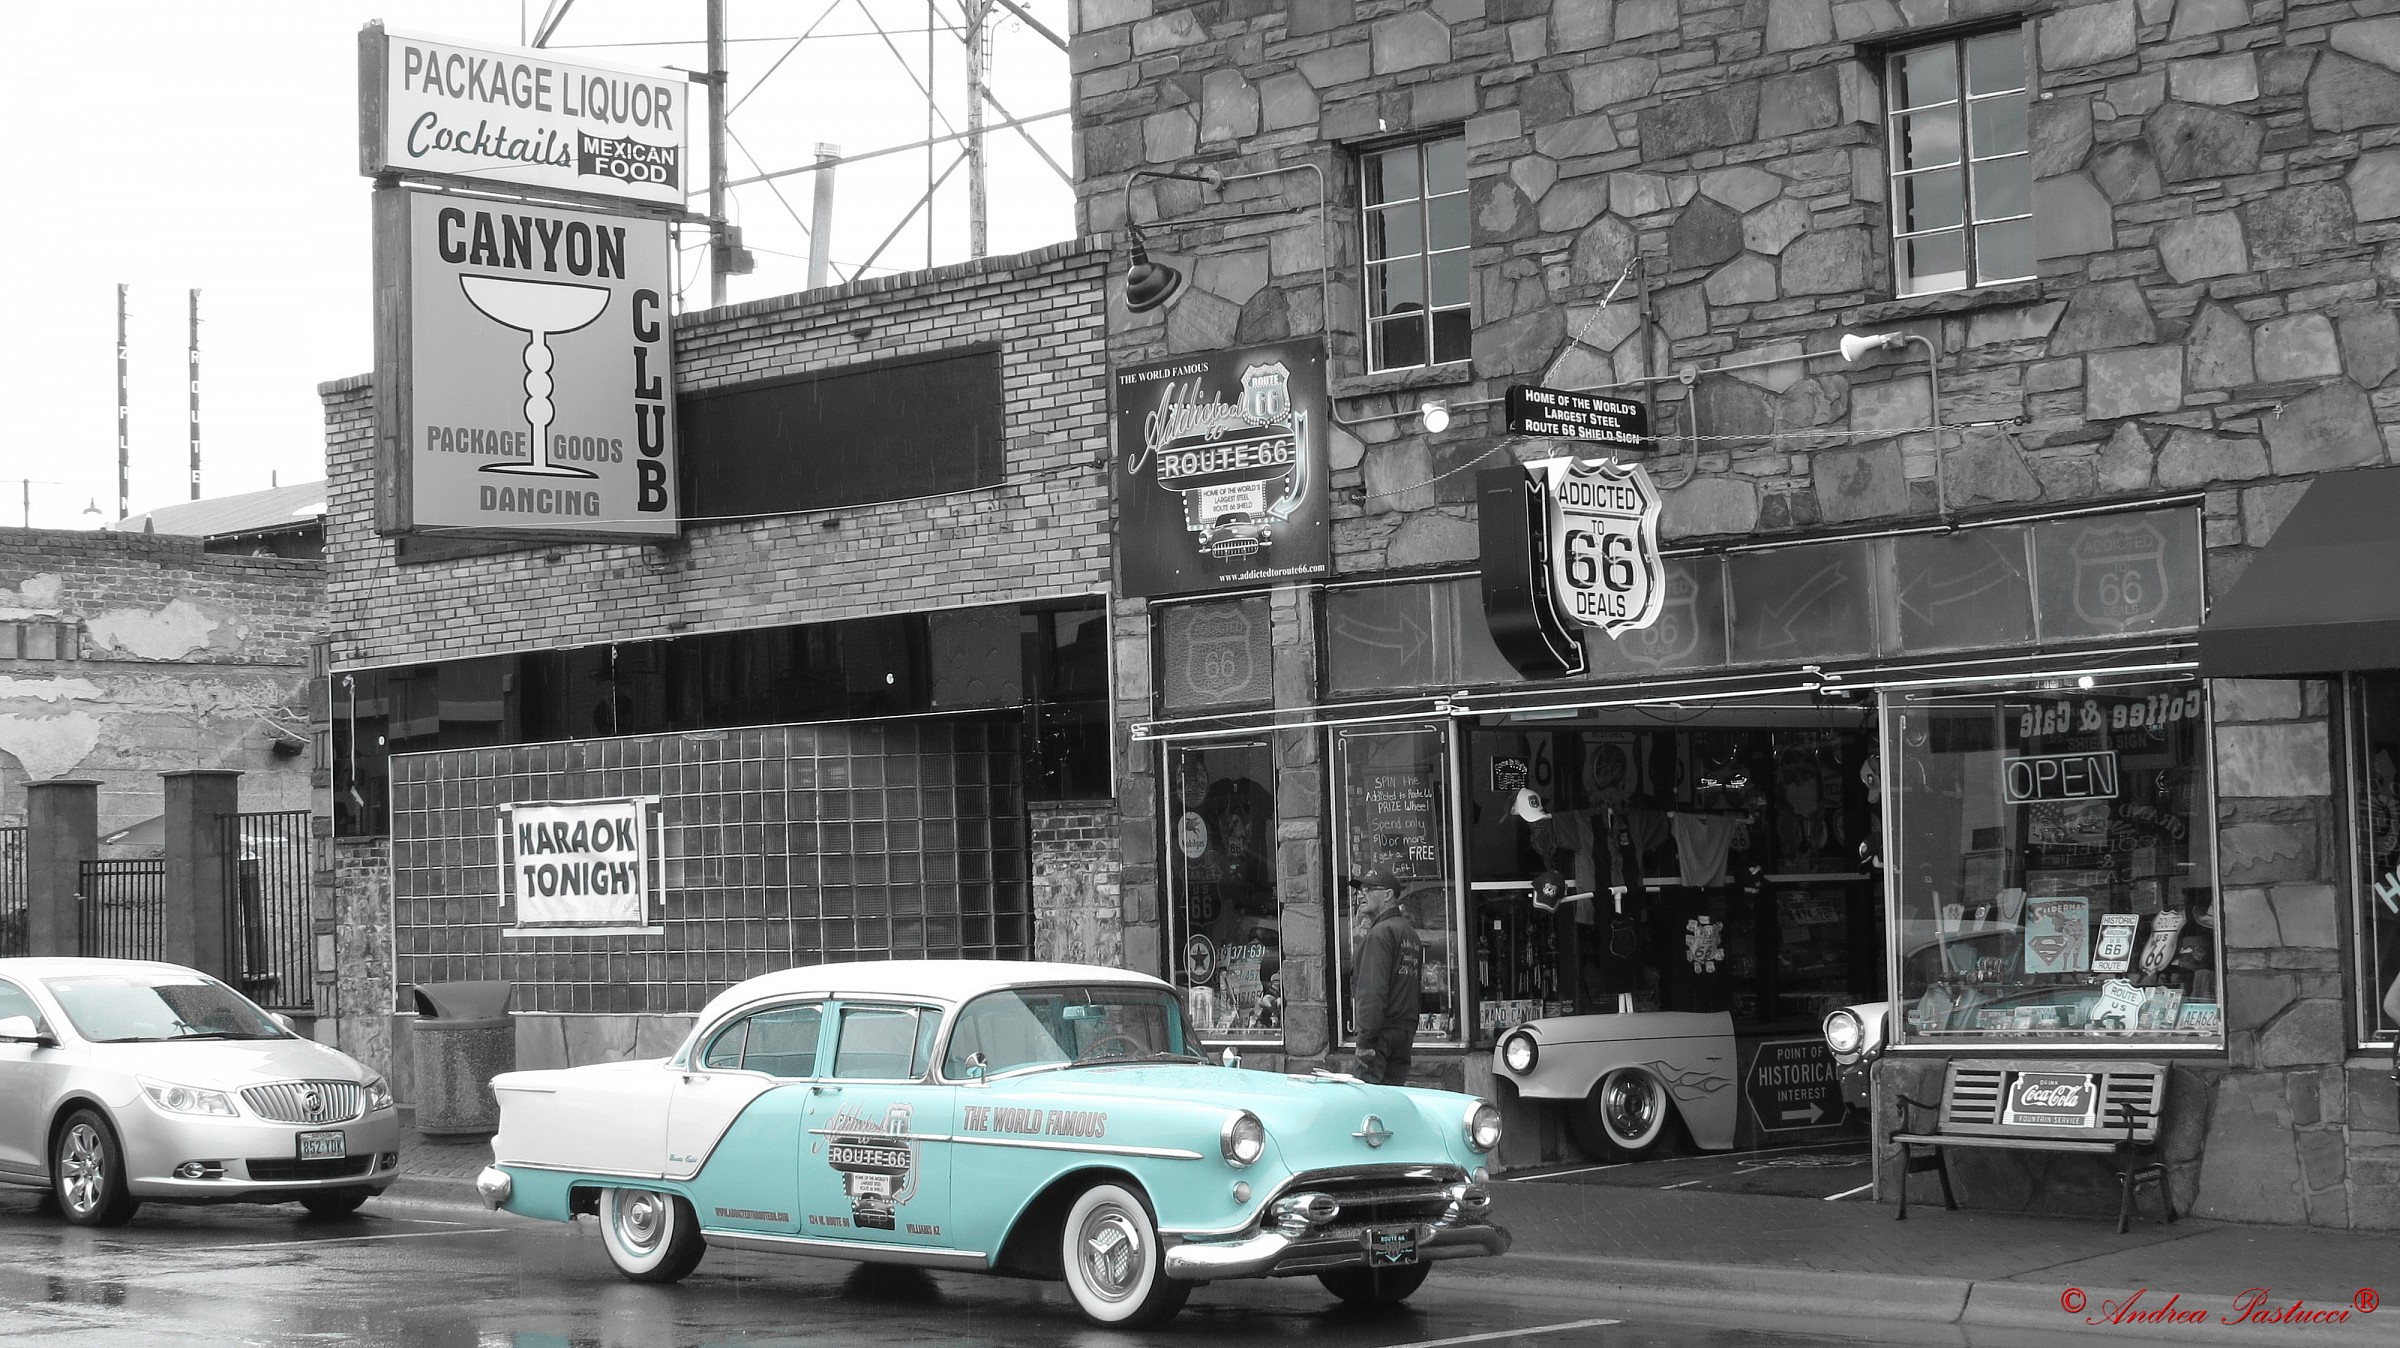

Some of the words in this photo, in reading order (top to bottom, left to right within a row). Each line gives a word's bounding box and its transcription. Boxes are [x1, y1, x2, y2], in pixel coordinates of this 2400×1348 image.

[404, 46, 553, 113] PACKAGE
[563, 72, 673, 131] LIQUOR
[407, 111, 571, 168] Cocktails
[583, 137, 675, 166] MEXICAN
[595, 157, 668, 184] FOOD
[438, 207, 626, 279] CANYON
[1119, 373, 1138, 385] THE
[1138, 368, 1171, 382] WORLD
[1172, 362, 1209, 377] FAMOUS
[1251, 373, 1280, 386] ROUTE
[632, 288, 668, 512] CLUB
[1255, 389, 1279, 416] 66
[1525, 389, 1556, 404] HOME
[1558, 395, 1570, 406] OF
[1572, 397, 1591, 409] THE
[1593, 399, 1636, 416] WORLD'S
[1128, 377, 1245, 475] Addicted
[1545, 406, 1587, 423] LARGEST
[1590, 413, 1621, 428] STEEL
[1205, 421, 1230, 441] to
[1525, 419, 1559, 434] ROUTE
[1561, 424, 1576, 436] 66
[1578, 426, 1614, 441] SHIELD
[1615, 431, 1641, 445] SIGN
[427, 425, 527, 457] PACKAGE
[553, 434, 623, 463] GOODS
[1165, 446, 1250, 477] ROUTE
[1257, 440, 1288, 464] 66
[480, 485, 600, 517] DANCING
[1203, 489, 1219, 497] HOME
[1220, 487, 1227, 495] OF
[1237, 484, 1261, 493] WORLD'S
[1215, 495, 1235, 504] LARGEST
[1236, 493, 1250, 502] STEEL
[1559, 481, 1636, 510] ADDICTED
[1213, 504, 1229, 512] ROUTE
[1237, 501, 1253, 509] SHIELD
[1591, 520, 1605, 536] TO
[1564, 529, 1637, 592] 66
[1219, 563, 1326, 582] www.addictedtoroute66.com
[2099, 570, 2142, 606] 66
[1576, 591, 1627, 617] DEALS
[1641, 614, 1678, 645] 66
[1205, 651, 1235, 678] 66
[1375, 776, 1395, 788] SPIN
[1403, 776, 1420, 786] the
[2008, 756, 2113, 799] OPEN
[1378, 801, 1401, 813] PRIZE
[1405, 800, 1429, 811] Wheel
[518, 817, 635, 857] KARAOK
[1372, 818, 1401, 832] Spend
[1406, 817, 1426, 837] only
[1389, 837, 1400, 846] or
[1403, 836, 1427, 844] more
[1379, 850, 1394, 863] get
[1409, 846, 1434, 860] FREE
[524, 861, 639, 898] TONIGHT
[2034, 903, 2086, 923] SUPERMAN
[2103, 917, 2137, 925] HISTORIC
[2157, 916, 2181, 929] ROUTE
[2156, 933, 2169, 941] US
[2104, 944, 2122, 956] 66
[2145, 944, 2167, 968] 66
[2099, 961, 2122, 970] ROUTE
[2111, 987, 2137, 1002] ROUTE
[2112, 1001, 2126, 1012] US
[1777, 1047, 1807, 1060] POINT
[1811, 1046, 1824, 1058] OF
[1777, 1087, 1826, 1101] INTEREST
[2021, 1084, 2083, 1107] Coca-Cola
[963, 1105, 992, 1131] THE
[993, 1107, 1043, 1134] WORLD
[1045, 1110, 1107, 1138] FAMOUS
[2019, 1115, 2052, 1123] FOUNTAIN
[2054, 1116, 2080, 1124] SERVICE
[832, 1147, 883, 1166] ROUTE
[888, 1151, 906, 1167] 66
[906, 1223, 932, 1235] WILLIAMS
